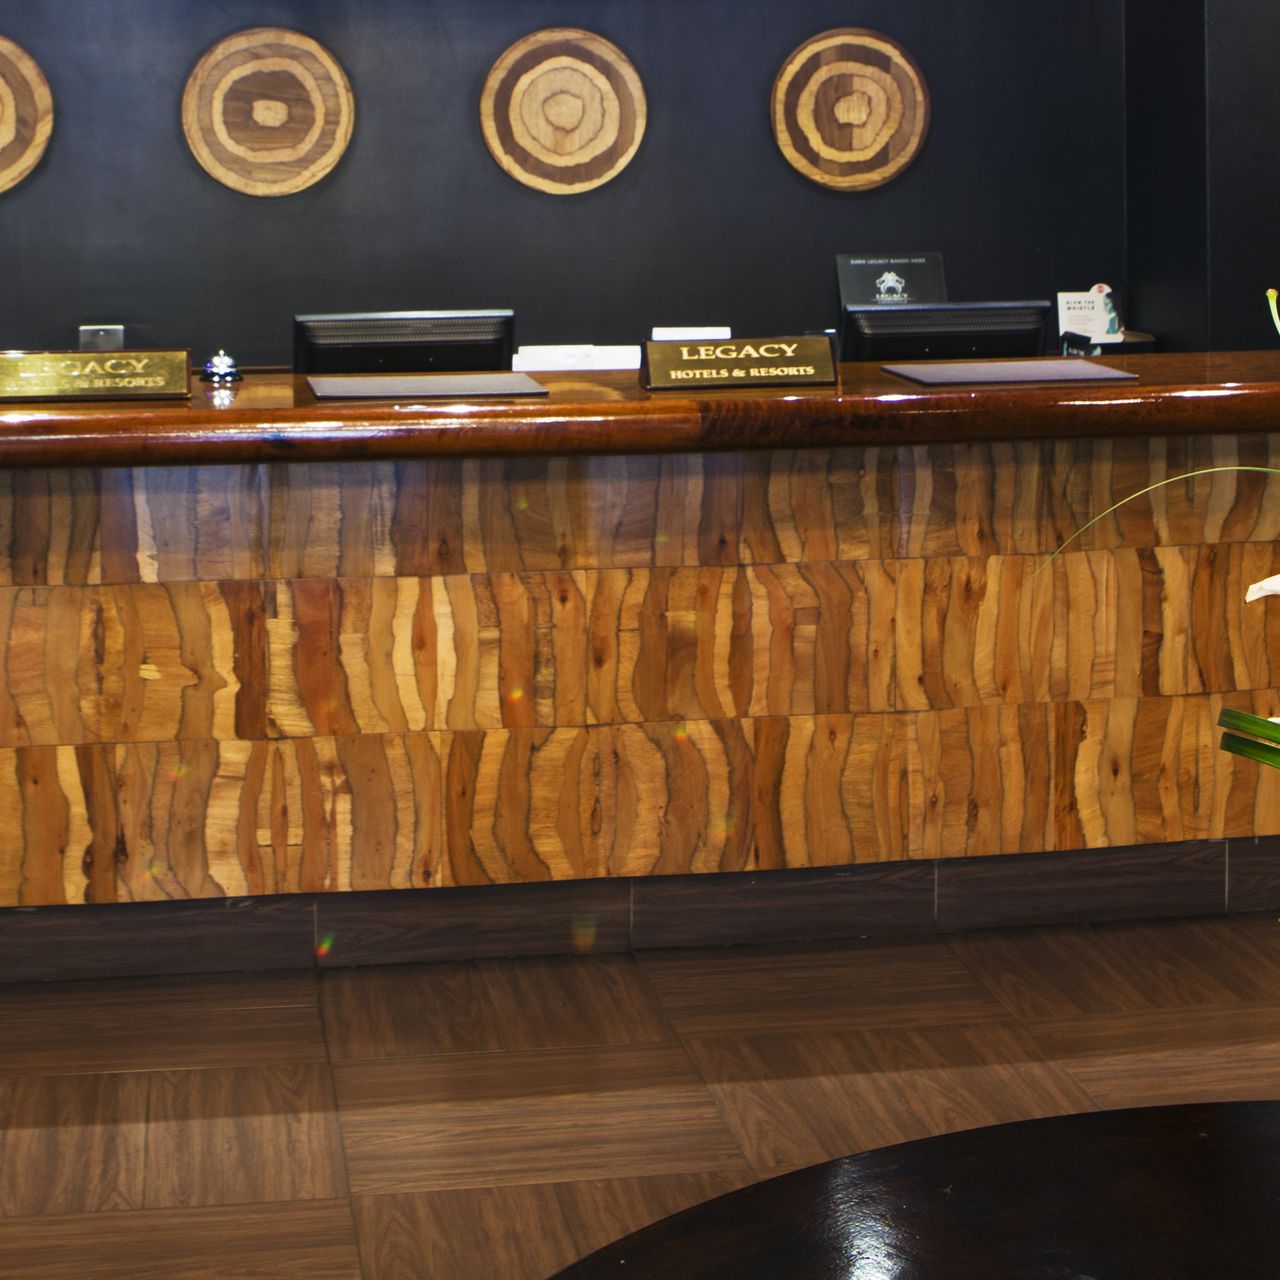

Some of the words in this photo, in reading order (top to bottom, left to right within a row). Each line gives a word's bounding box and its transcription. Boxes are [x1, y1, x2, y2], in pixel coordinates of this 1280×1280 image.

[680, 343, 798, 360] LEGACY
[670, 368, 729, 379] HOTELS
[732, 368, 746, 378] &
[750, 366, 815, 377] RESORTS
[94, 376, 166, 388] RESORTS
